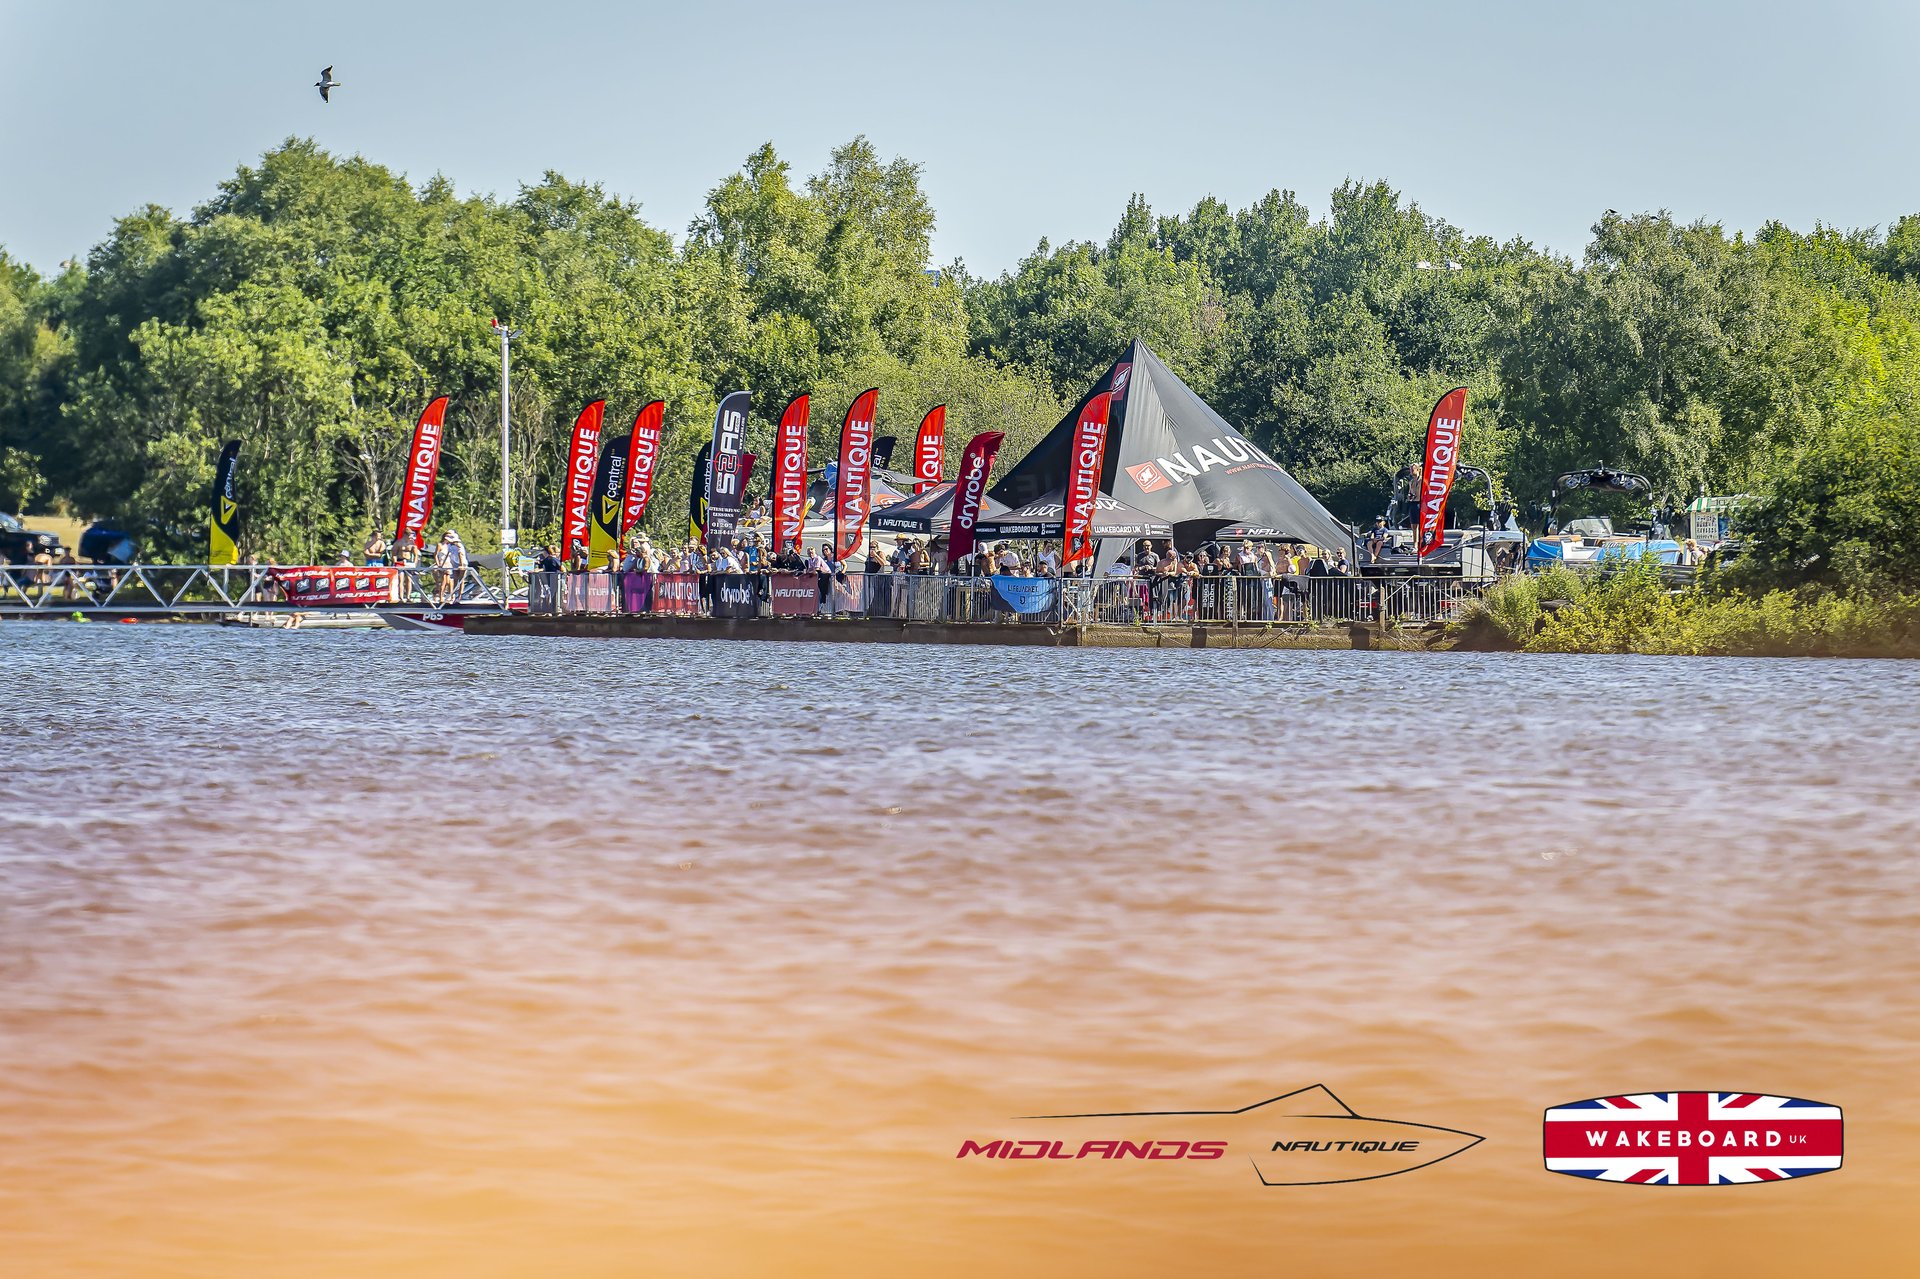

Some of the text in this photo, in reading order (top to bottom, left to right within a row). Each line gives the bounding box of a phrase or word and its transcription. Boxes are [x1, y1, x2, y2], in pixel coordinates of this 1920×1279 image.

[406, 423, 438, 528] NAUTIQUE
[571, 428, 596, 536] NAUTIQUE
[607, 455, 622, 498] central
[626, 427, 656, 524] AUTIQUE
[783, 425, 802, 536] NAUTIQUE
[845, 420, 869, 530] NAUTIQUE
[1072, 421, 1103, 535] NAUTIQUE
[1424, 417, 1456, 529] NAUTIQUE
[882, 518, 918, 529] NAUTIQUE
[1000, 525, 1031, 534] WAKEBOARD
[1094, 525, 1132, 534] WAKEBOARD
[665, 582, 699, 600] NAUTIQU
[775, 589, 815, 597] NAUTIQUE
